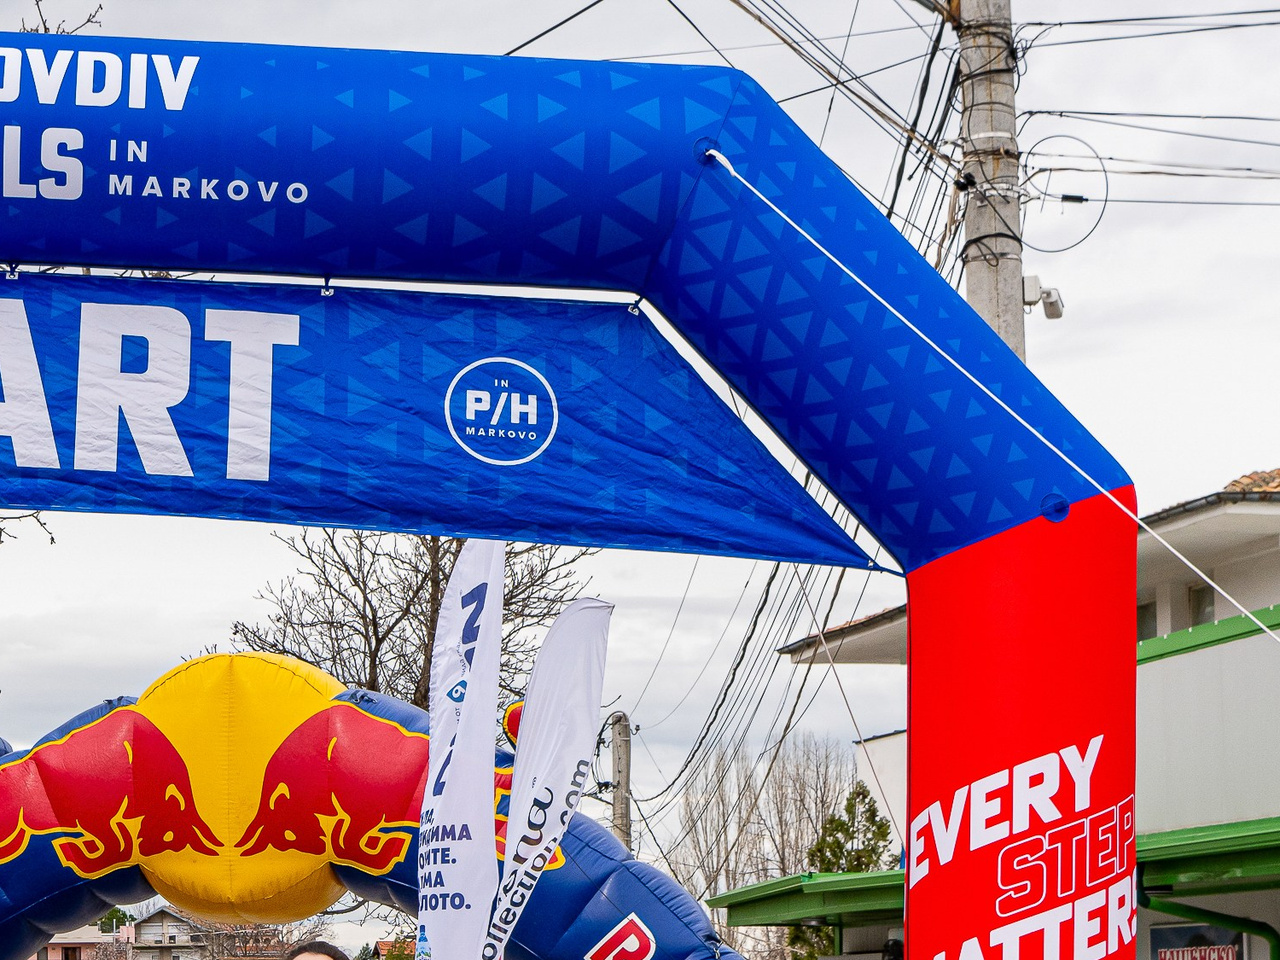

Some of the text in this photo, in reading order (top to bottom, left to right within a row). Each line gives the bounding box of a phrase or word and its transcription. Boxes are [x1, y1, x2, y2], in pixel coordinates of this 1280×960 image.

[108, 139, 148, 163] IN
[108, 174, 308, 204] MARKOVO
[494, 379, 509, 388] IN
[465, 389, 538, 425] P/H
[466, 426, 537, 440] MARKOVO
[910, 734, 1105, 890] EVERY
[995, 793, 1135, 918] STEP
